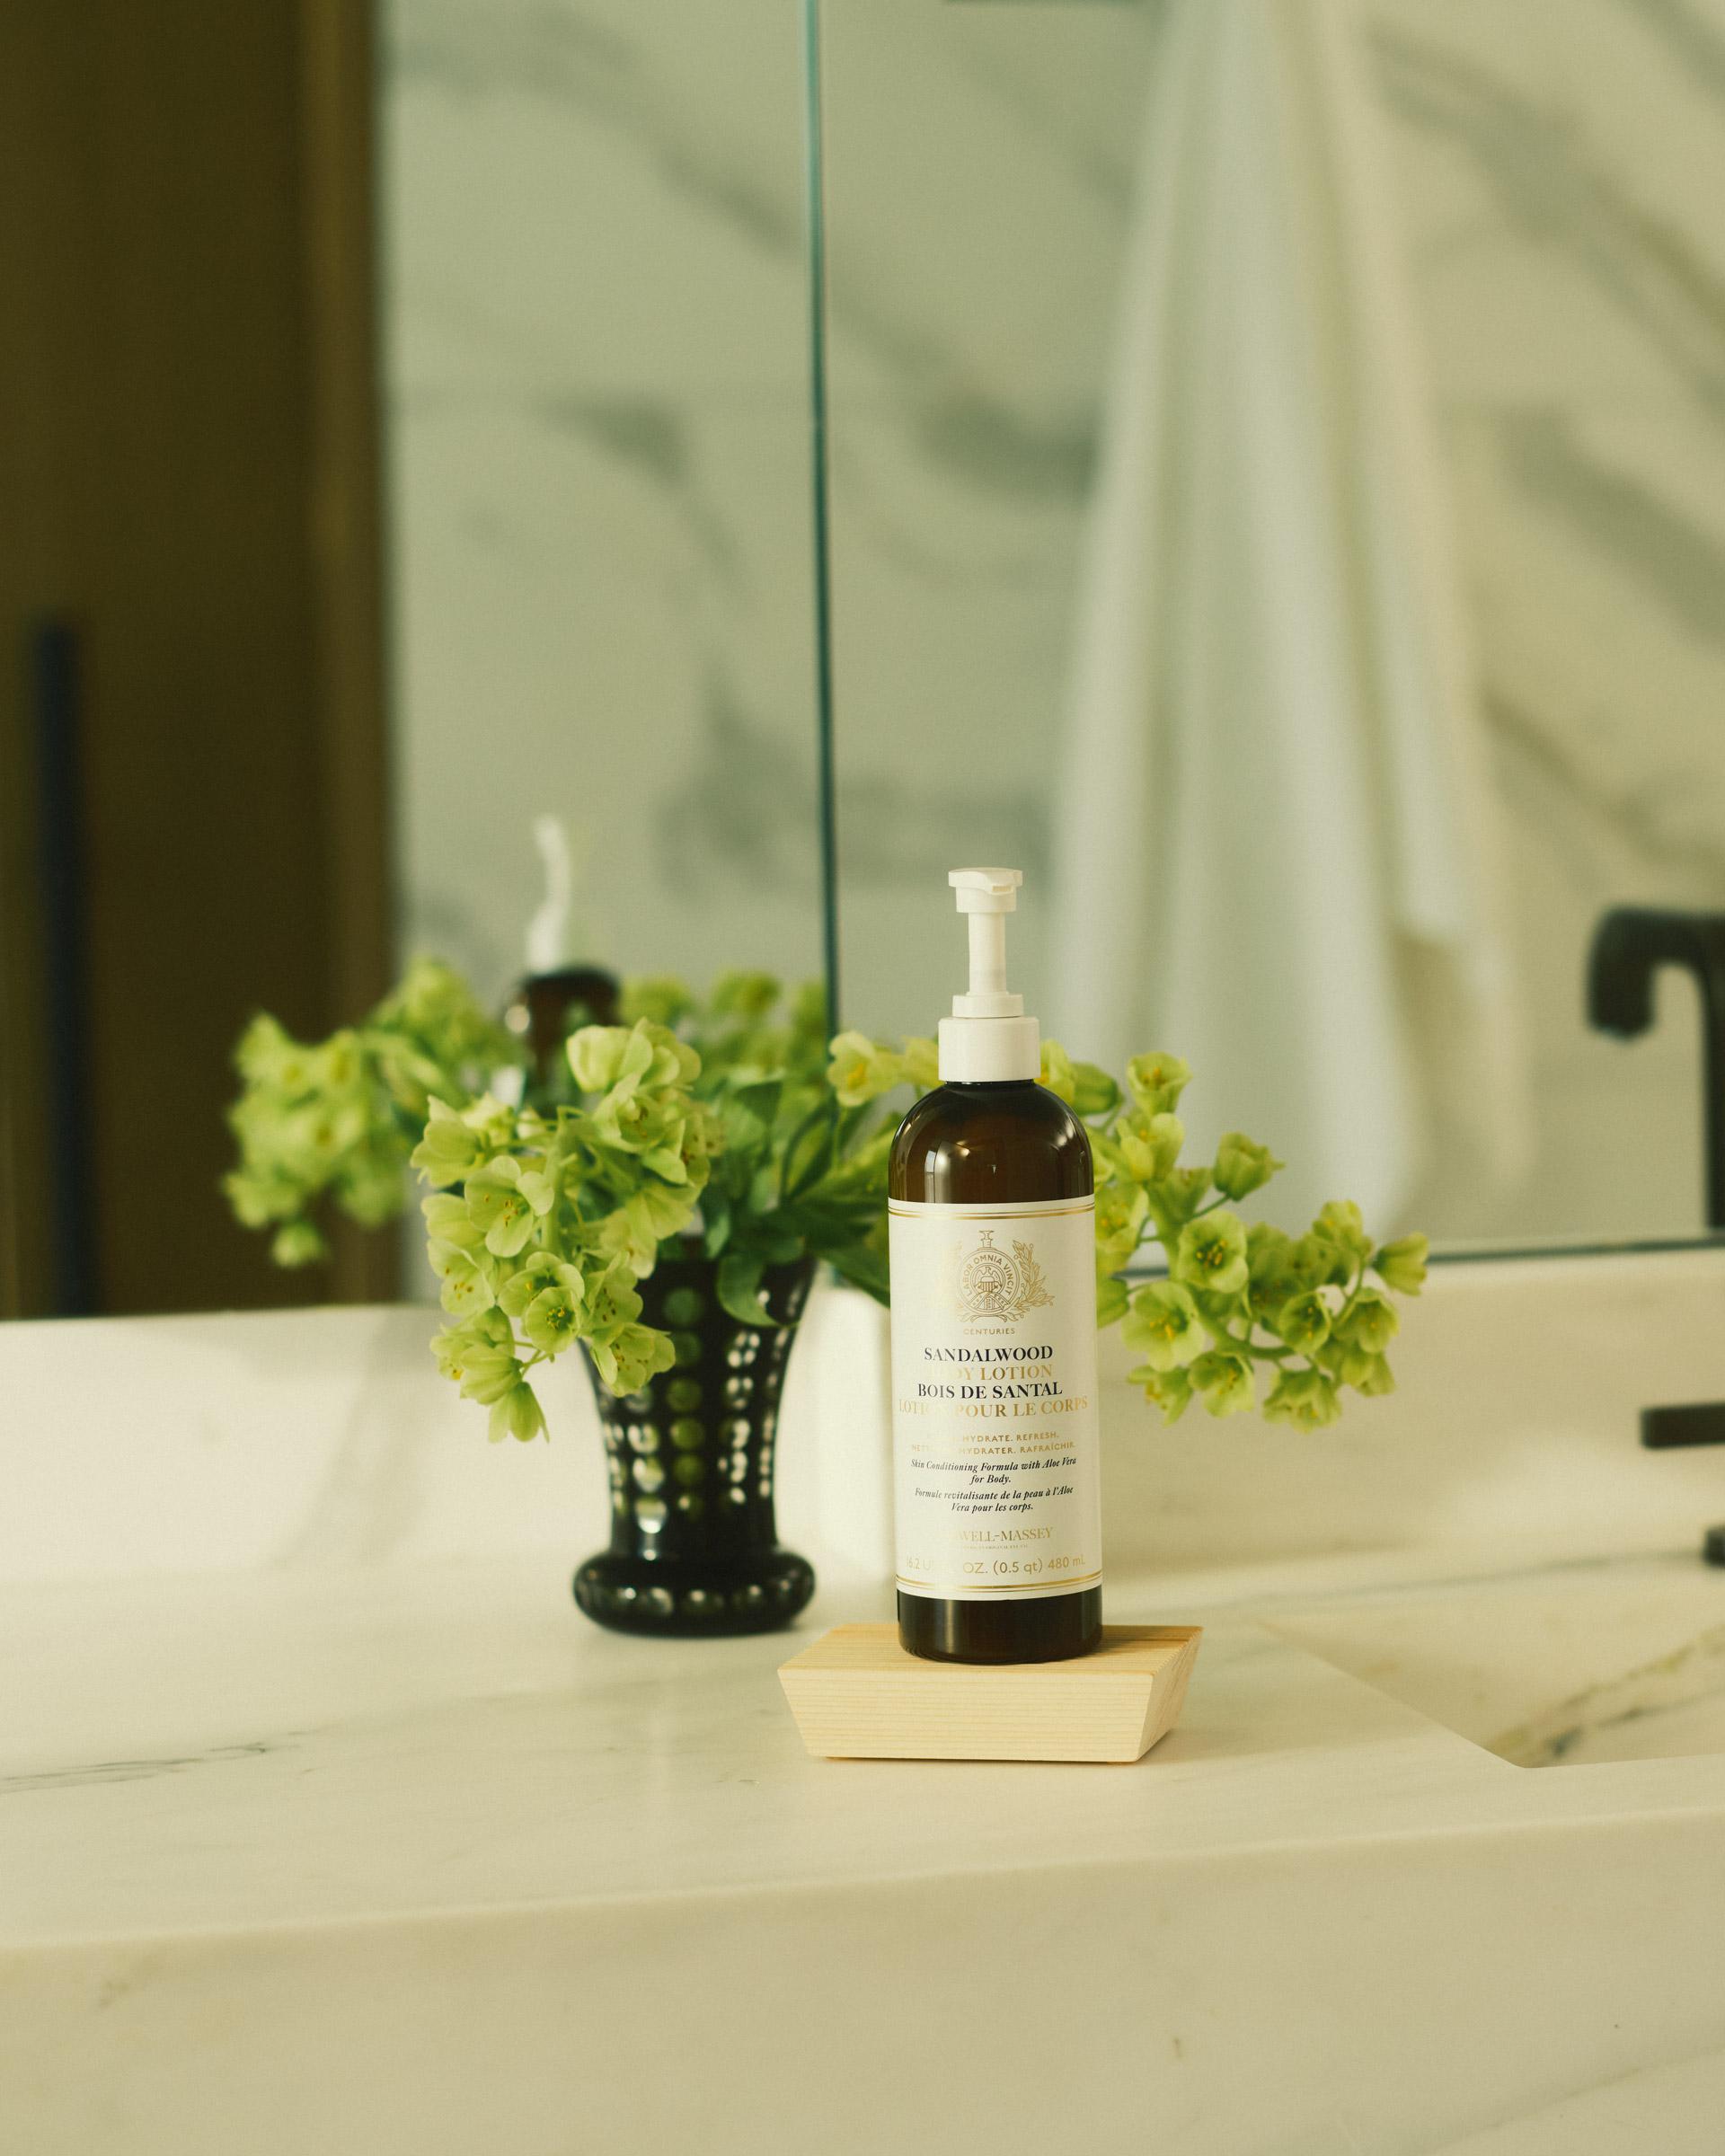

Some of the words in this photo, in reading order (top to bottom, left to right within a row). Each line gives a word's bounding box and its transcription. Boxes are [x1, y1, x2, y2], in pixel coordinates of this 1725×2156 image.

[973, 1254, 1002, 1266] OMNIA
[1003, 1263, 1014, 1295] VINCIT
[963, 1327, 1015, 1336] CENTURIES
[924, 1345, 1054, 1362] SANDALWOOD
[980, 1364, 1053, 1381] LOTION
[917, 1383, 955, 1399] BOIS
[960, 1385, 987, 1400] DE
[992, 1382, 1063, 1399] SANTAL
[956, 1403, 1007, 1418] POUR
[1013, 1402, 1036, 1417] LE
[1040, 1395, 1088, 1414] CORPS
[962, 1434, 1013, 1443] HYDRATE.
[1016, 1432, 1059, 1442] REFRESH.
[910, 1458, 924, 1469] Skin
[926, 1461, 978, 1473] Conditioning
[981, 1462, 1018, 1471] Formula
[1021, 1461, 1040, 1471] with
[1041, 1458, 1060, 1469] Aloe
[1061, 1456, 1077, 1467] Vera
[969, 1474, 985, 1486] for
[987, 1474, 1012, 1485] Body.
[915, 1487, 942, 1498] Formule
[943, 1489, 998, 1500] revitalisante
[1000, 1489, 1011, 1500] de
[1012, 1489, 1022, 1499] la
[1023, 1489, 1044, 1500] peau
[951, 1502, 969, 1512] Vera
[971, 1505, 994, 1515] pour
[995, 1502, 1006, 1512] les
[1008, 1503, 1033, 1514] corps.
[947, 1526, 1053, 1542] WELL-MASSEY
[962, 1561, 988, 1574] OZ.
[992, 1559, 1020, 1576] (0.5
[1022, 1558, 1044, 1576] qt)
[1047, 1556, 1069, 1569] 480
